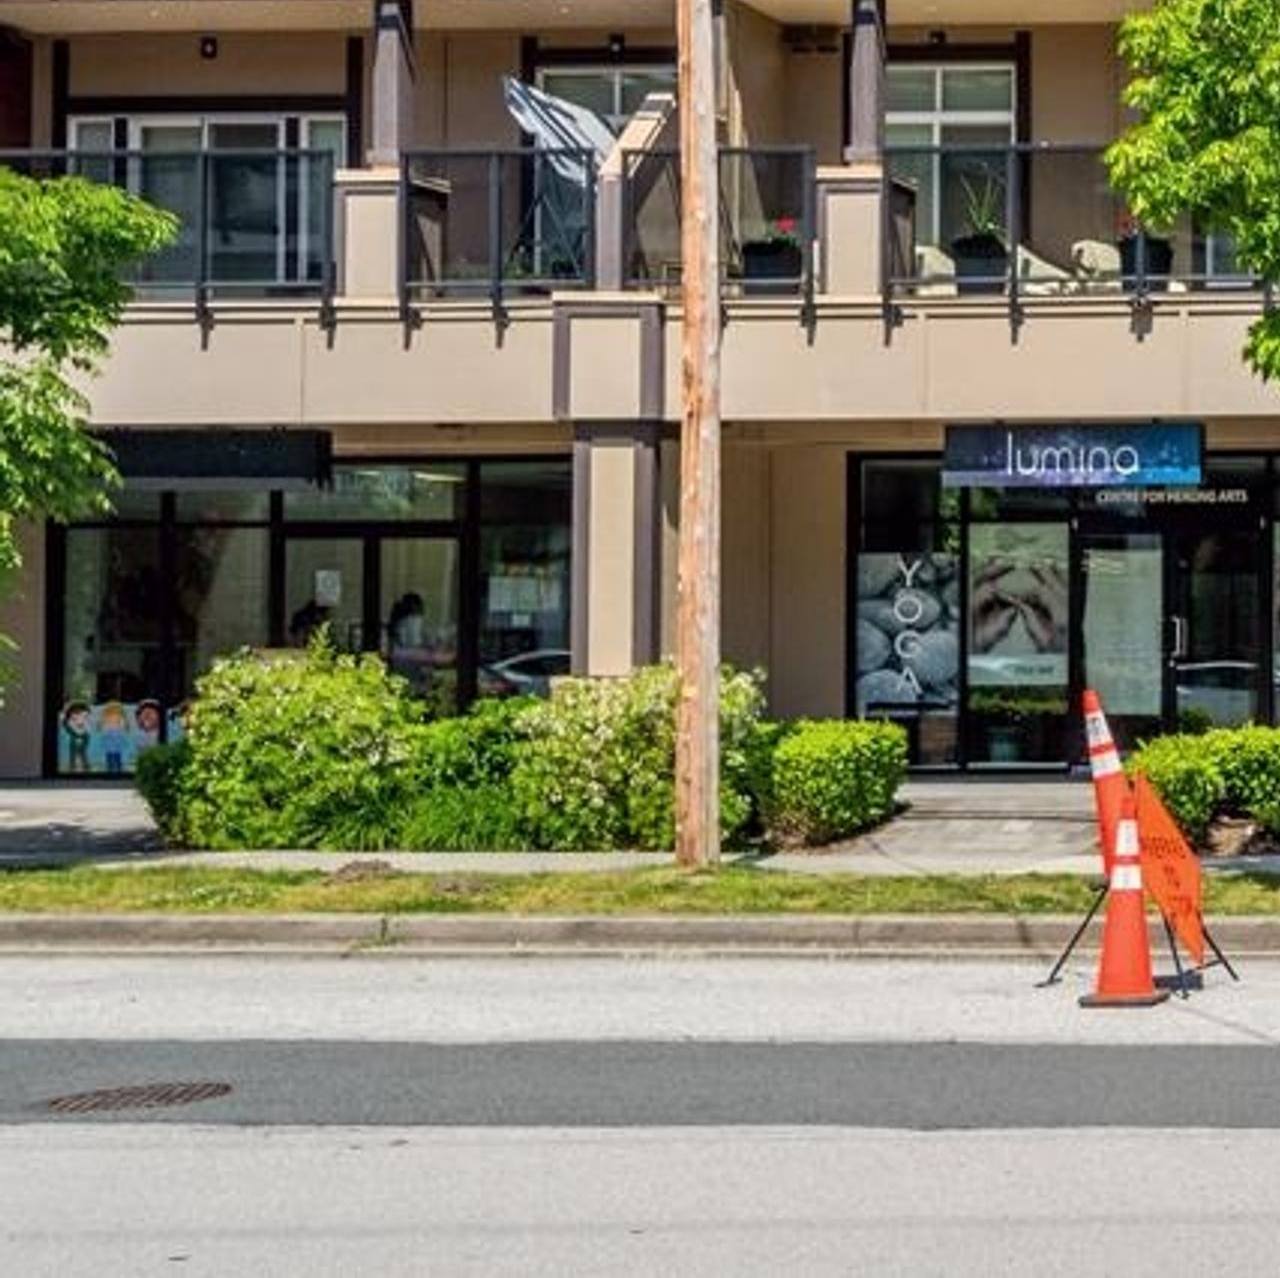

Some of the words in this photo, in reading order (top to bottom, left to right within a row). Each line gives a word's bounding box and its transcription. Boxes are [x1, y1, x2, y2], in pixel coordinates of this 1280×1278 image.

[1007, 433, 1140, 475] lumina
[1218, 489, 1248, 502] ARTS
[893, 557, 922, 694] YOGA
